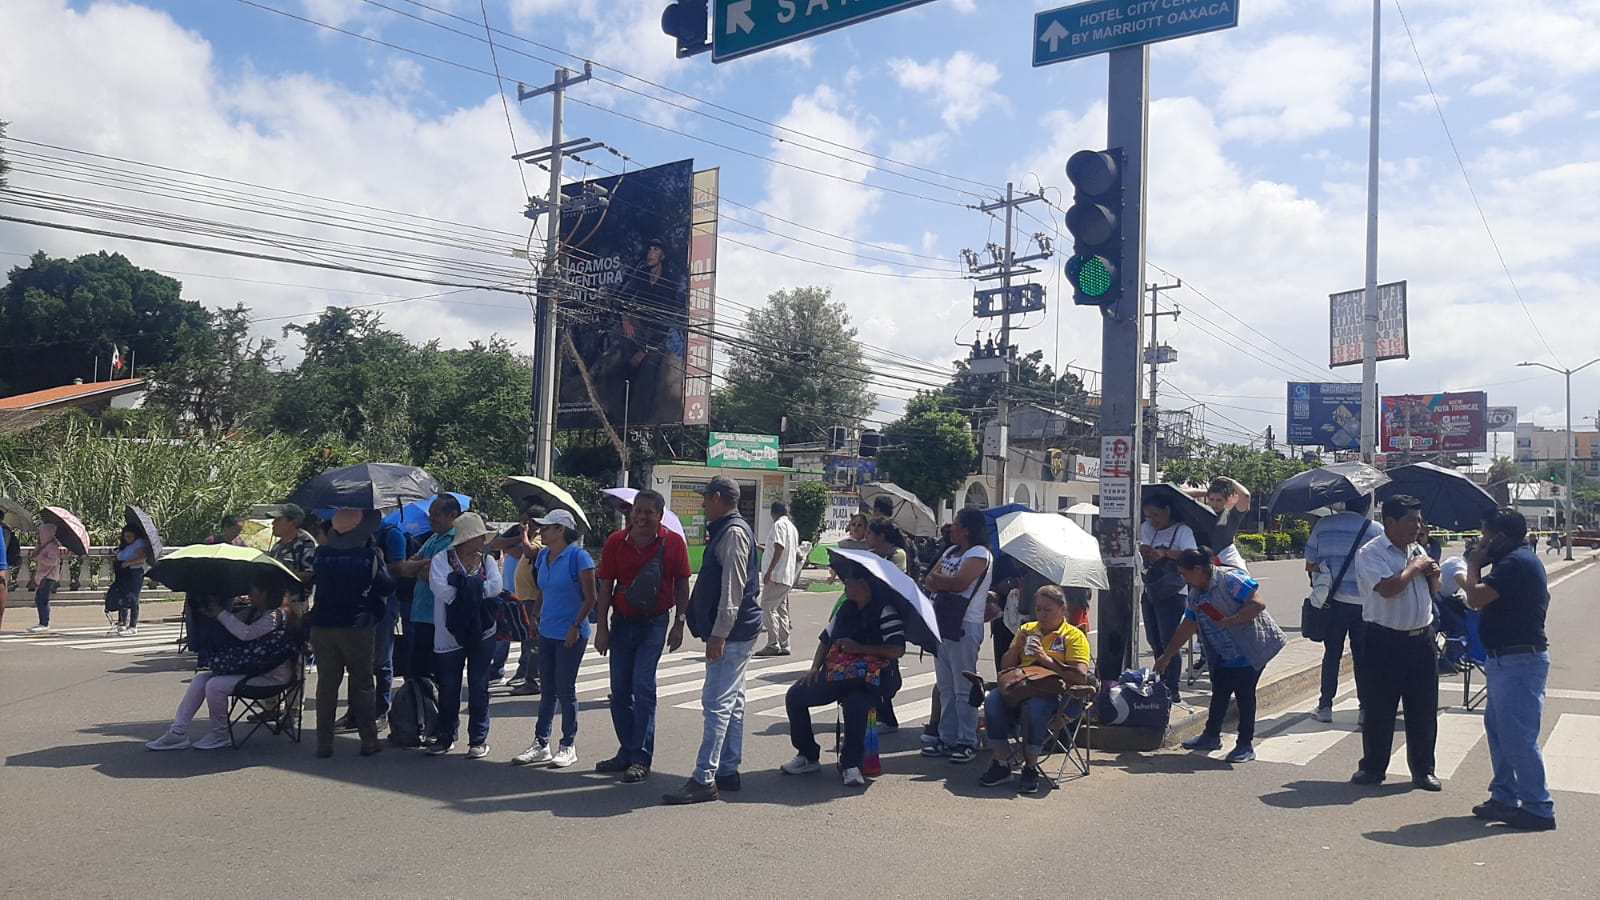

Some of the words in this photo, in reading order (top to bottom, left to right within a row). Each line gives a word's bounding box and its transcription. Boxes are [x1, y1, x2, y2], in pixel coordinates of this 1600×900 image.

[777, 0, 860, 24] SA
[1072, 32, 1089, 45] BY
[1092, 15, 1164, 40] MARRIOTT
[1167, 1, 1229, 25] OAXACA
[1080, 9, 1123, 28] HOTEL
[1127, 0, 1157, 16] CITY
[1487, 410, 1513, 425] ico
[832, 507, 848, 519] PLAZA
